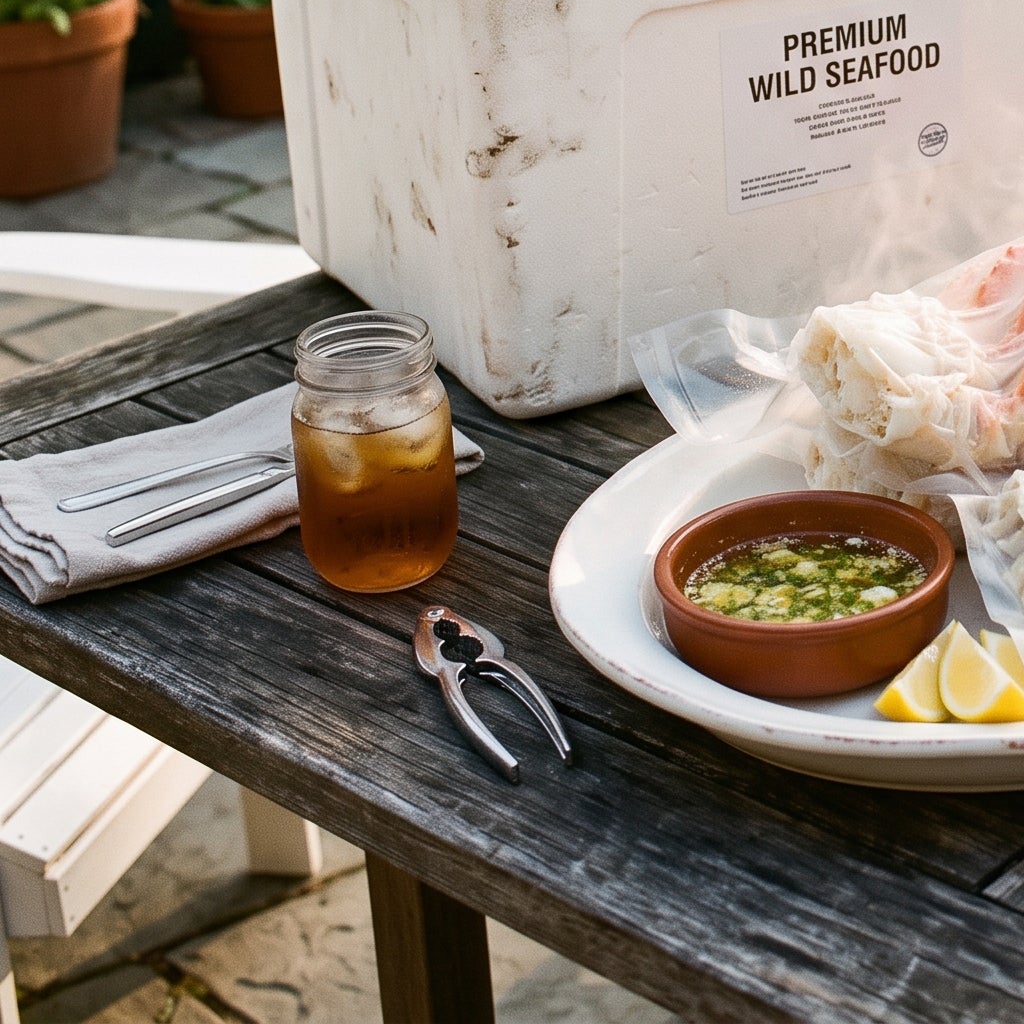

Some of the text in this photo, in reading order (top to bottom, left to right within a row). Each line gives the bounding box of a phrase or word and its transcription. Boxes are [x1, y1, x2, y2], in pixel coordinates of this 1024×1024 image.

[783, 13, 907, 61] PREMIUM
[749, 66, 816, 103] WILD
[826, 42, 940, 88] SEAFOOD
